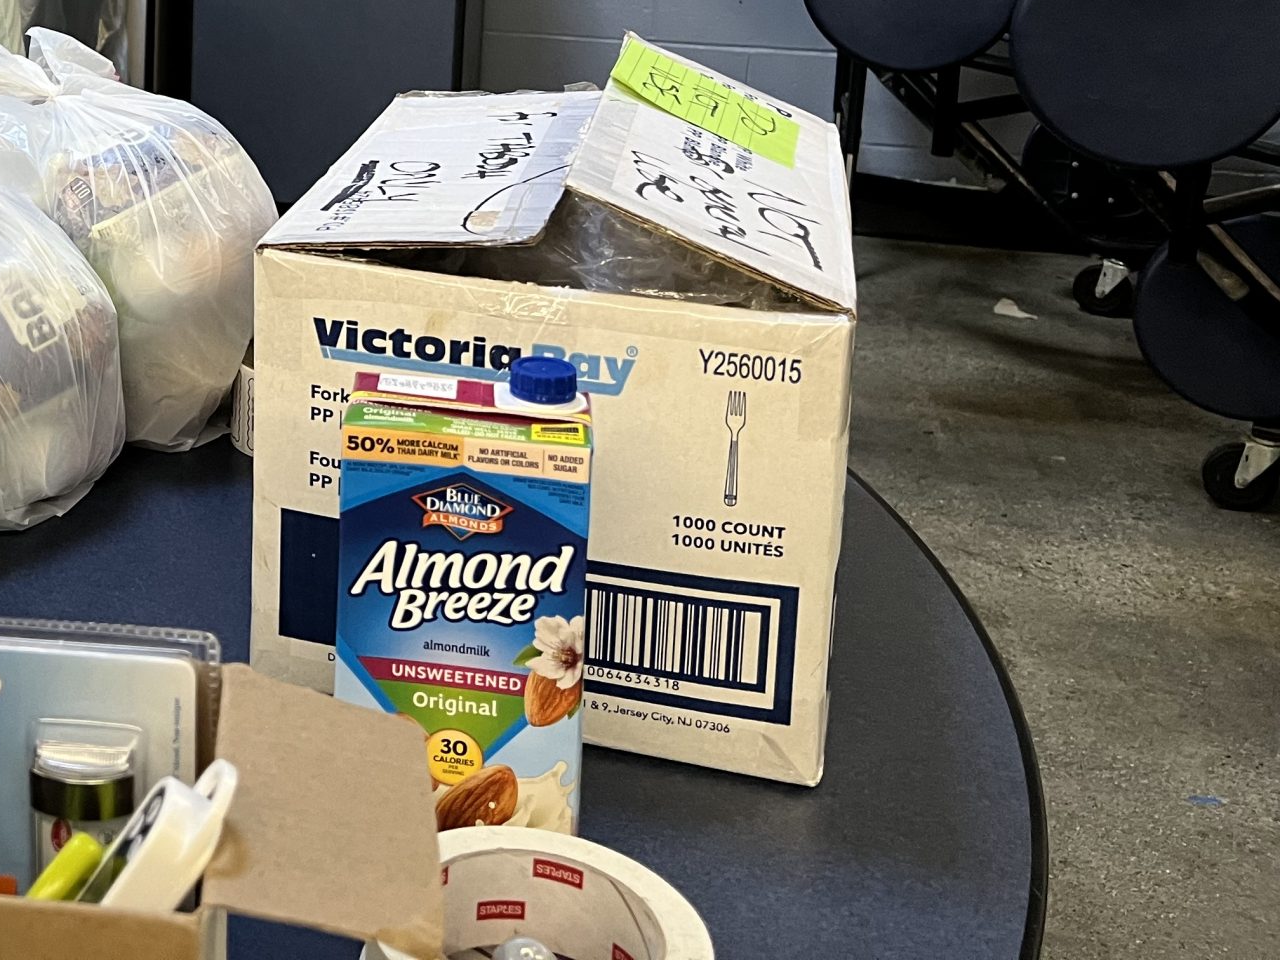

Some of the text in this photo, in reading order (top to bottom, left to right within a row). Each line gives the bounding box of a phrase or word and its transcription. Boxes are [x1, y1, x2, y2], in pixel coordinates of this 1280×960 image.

[313, 317, 523, 372] Victoria
[698, 347, 803, 385] Y2560015
[346, 435, 395, 454] 50%
[397, 438, 459, 452] MORE CALCIUM
[397, 447, 416, 456] THAN
[418, 448, 439, 458] DAIRY
[479, 447, 528, 460] NO ARTIFICIAL
[467, 455, 540, 470] FLAVORS OR COLORS
[548, 454, 584, 465] NO ADDED
[553, 464, 578, 474] SUGAR
[309, 472, 333, 489] PP
[445, 488, 482, 505] BLUE
[426, 496, 501, 518] DIAMOND
[430, 513, 498, 532] ALMONDS
[672, 515, 787, 540] 1000 COUNT
[671, 533, 785, 559] 1000 UNITÉS
[350, 540, 575, 595] Almond
[391, 589, 537, 630] Breeze
[422, 639, 491, 658] almondmilk
[391, 663, 522, 692] UNSWEETENED
[586, 664, 681, 692] 0064634318
[412, 690, 498, 717] Original
[590, 700, 600, 711] &
[602, 702, 612, 714] 9,
[613, 704, 649, 723] Jersey
[651, 711, 675, 726] City,
[677, 716, 693, 727] NJ
[695, 719, 732, 734] 07306
[440, 738, 468, 757] 30
[432, 754, 476, 768] CALORIES
[535, 862, 581, 885] STAPLES
[478, 904, 523, 917] STAPLES
